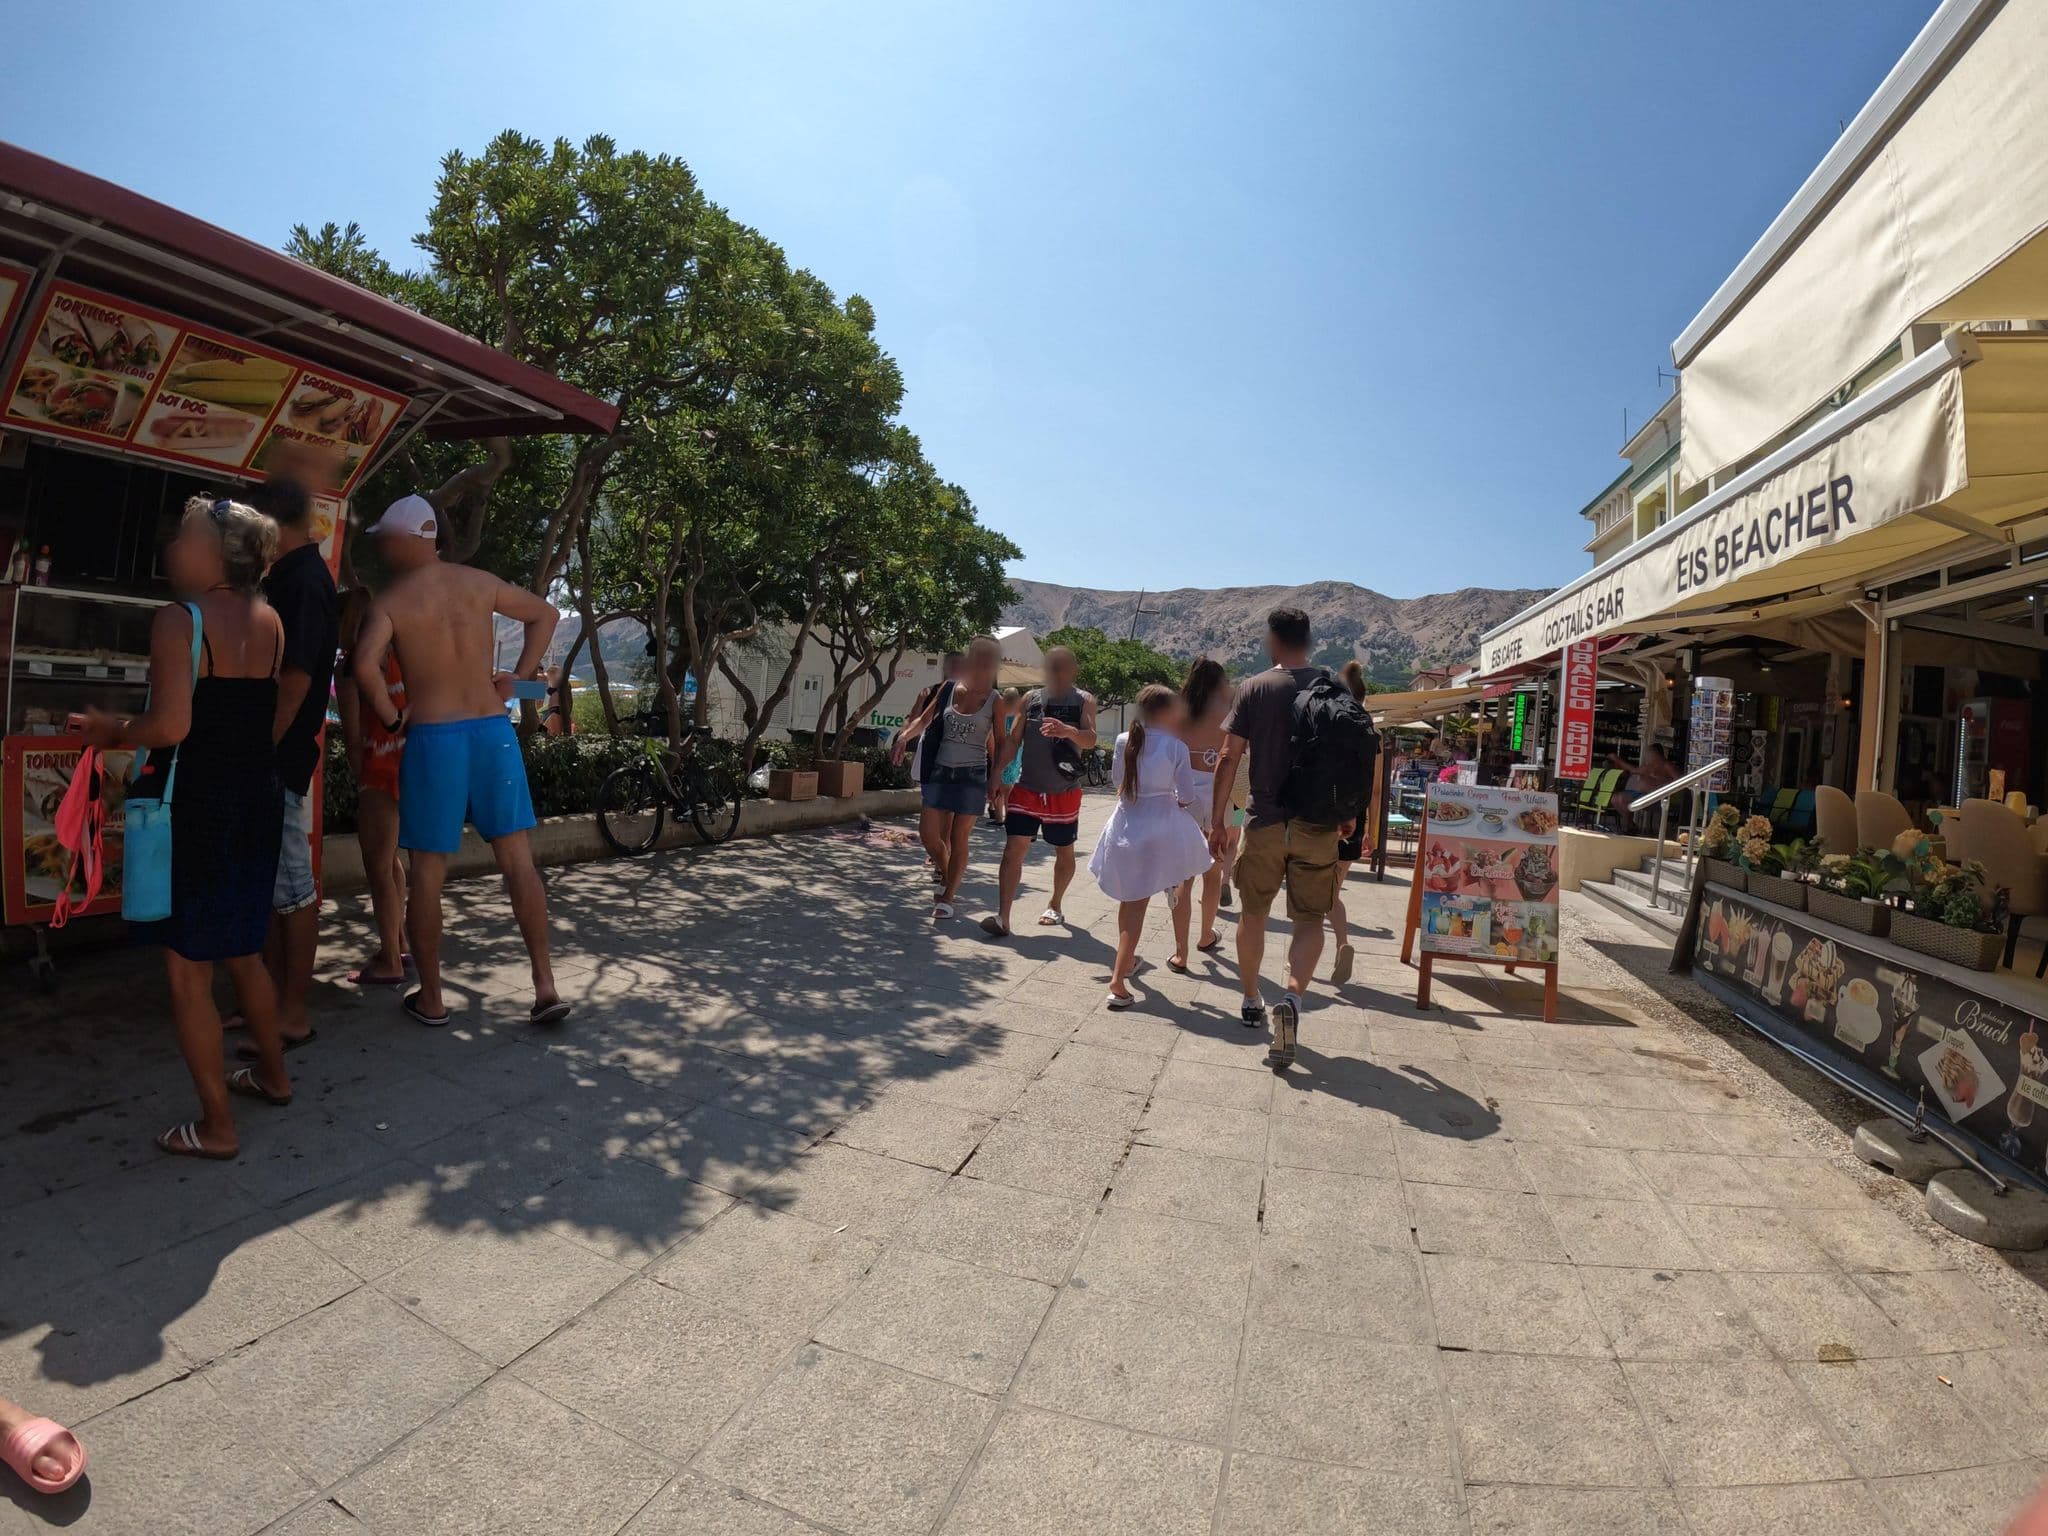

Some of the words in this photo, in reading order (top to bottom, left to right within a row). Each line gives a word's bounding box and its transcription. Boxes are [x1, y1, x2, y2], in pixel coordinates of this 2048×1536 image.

[180, 398, 207, 414] DOG
[1677, 546, 1708, 593] EIS
[1715, 474, 1857, 577] BEACHER
[1545, 603, 1593, 647] COCTAILS
[1596, 587, 1624, 626] BAR
[1491, 648, 1501, 669] EIS
[1502, 637, 1523, 665] CAFFE
[1568, 640, 1594, 710] OBACCO
[1564, 721, 1589, 767] SHOP
[2021, 1078, 2031, 1094] Ice
